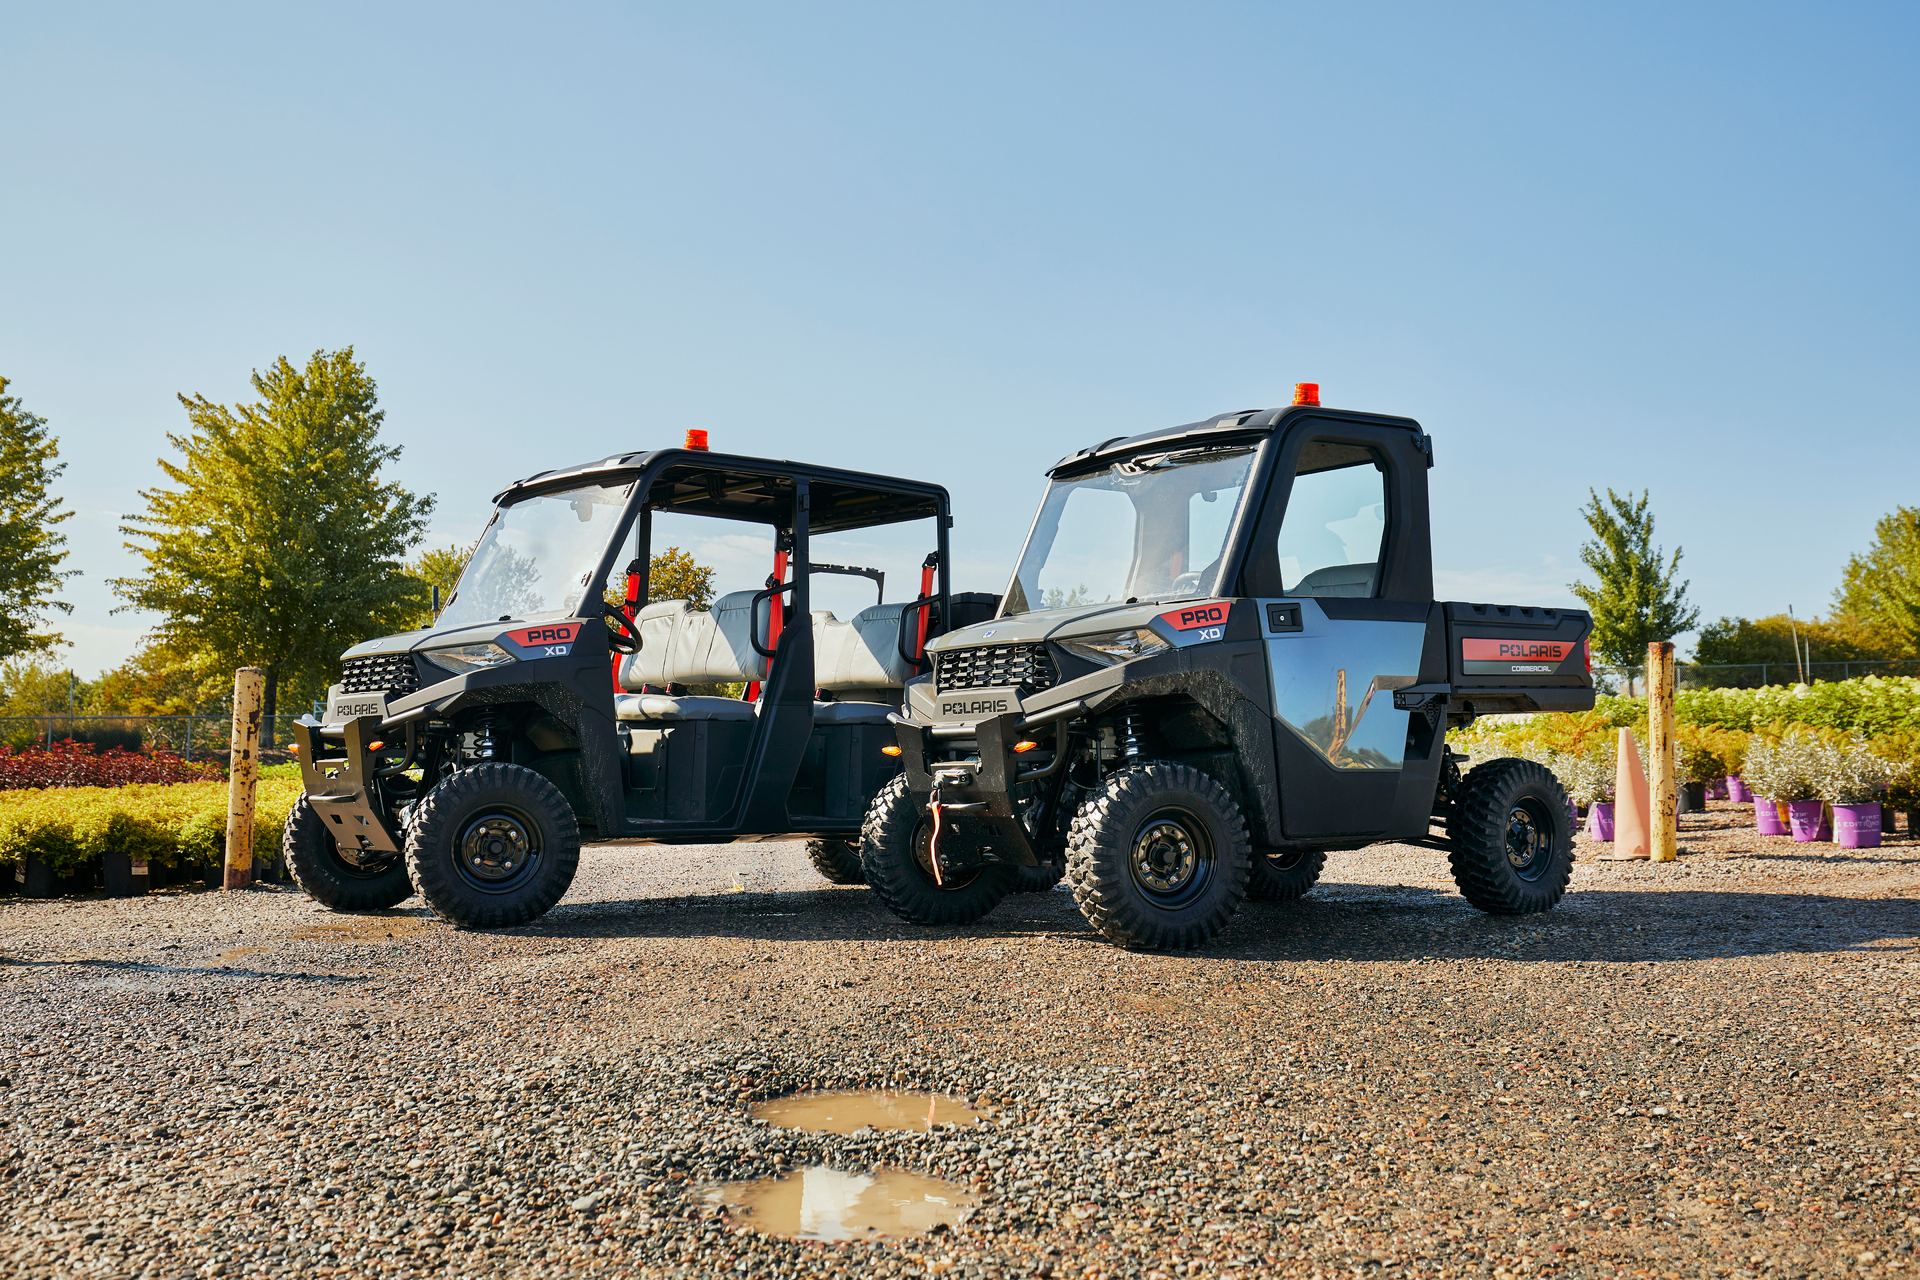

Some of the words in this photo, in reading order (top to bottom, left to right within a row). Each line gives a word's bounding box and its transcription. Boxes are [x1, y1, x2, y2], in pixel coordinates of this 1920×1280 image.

[1181, 608, 1222, 625] PRO
[527, 628, 571, 642] PRO
[1198, 628, 1221, 640] XD
[544, 645, 567, 656] XD
[1499, 644, 1562, 657] POLARIS
[337, 703, 378, 716] POLARIS
[942, 699, 1008, 715] POLARIS
